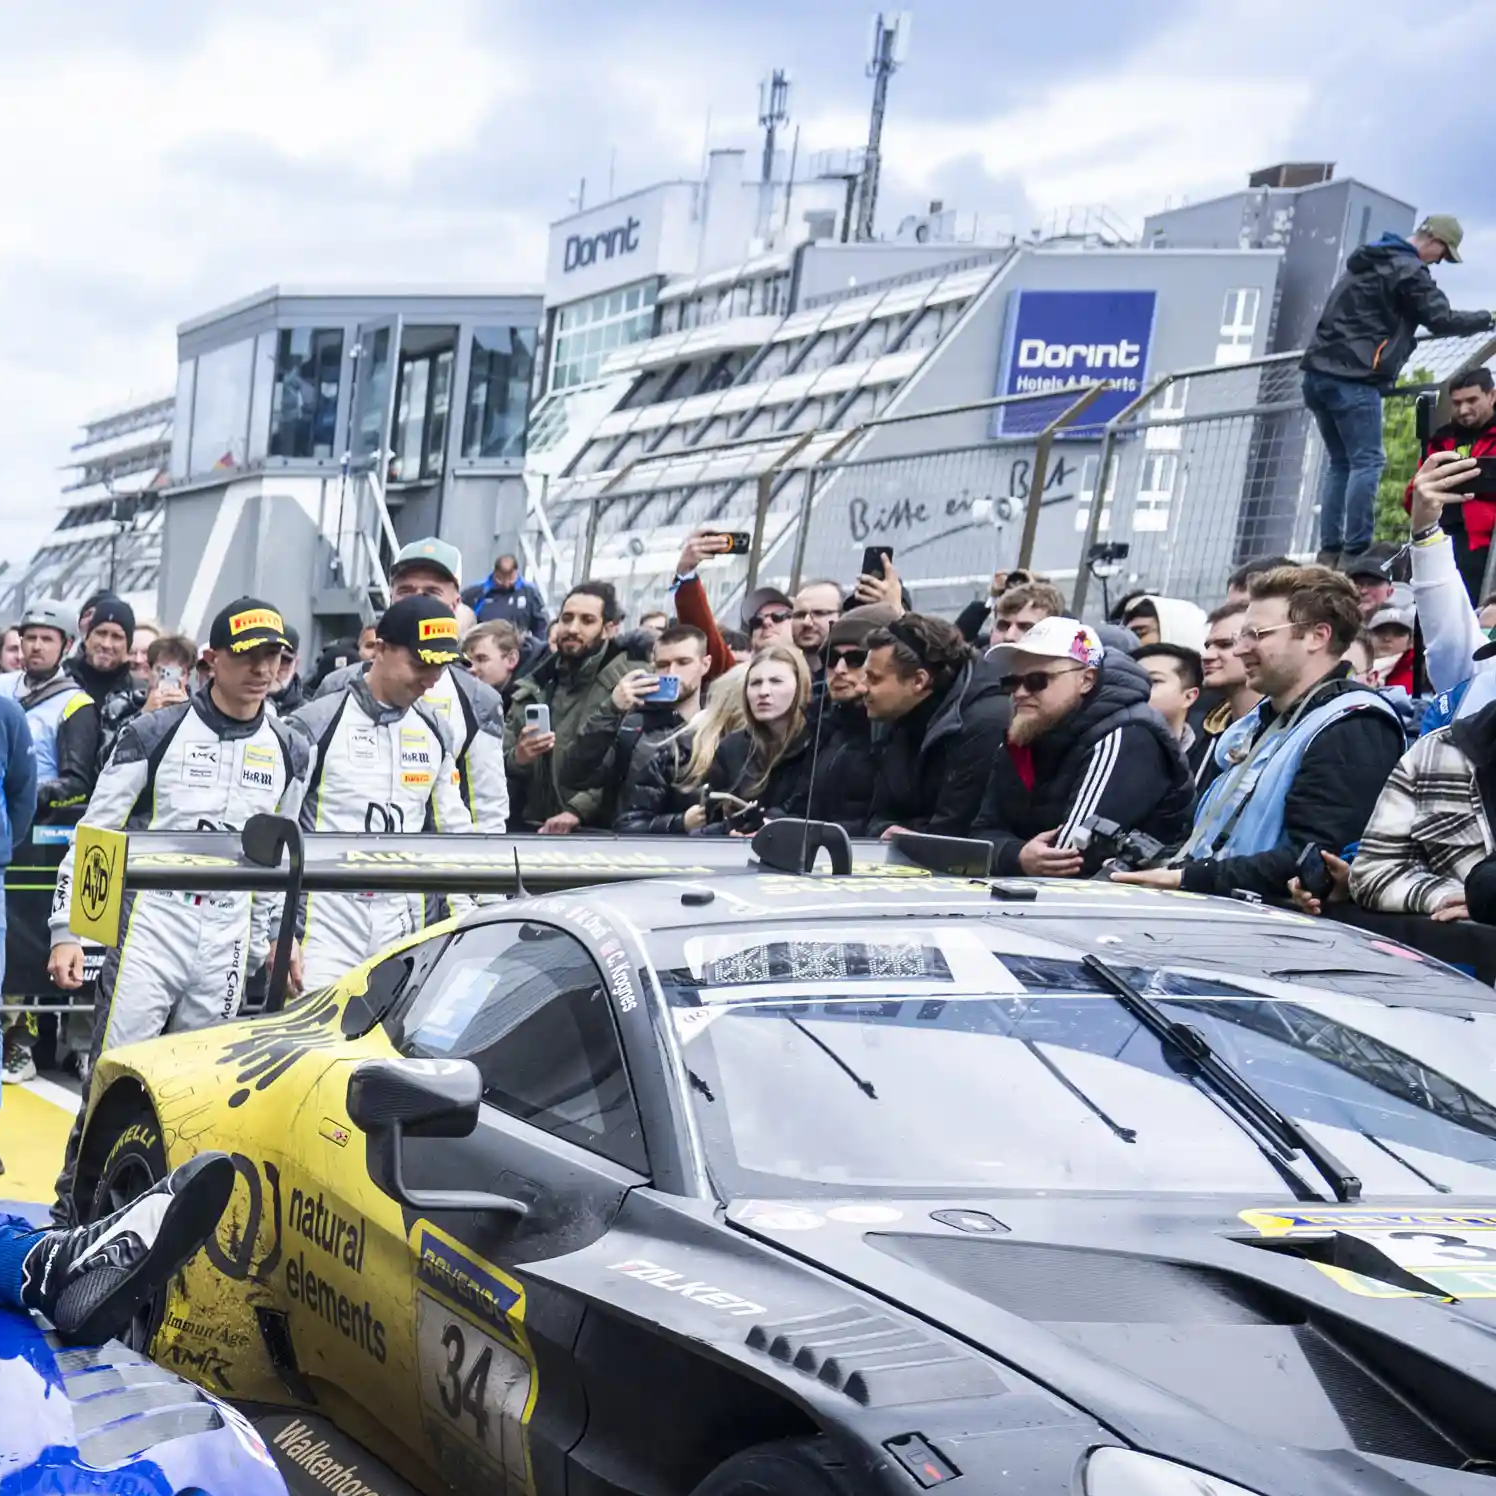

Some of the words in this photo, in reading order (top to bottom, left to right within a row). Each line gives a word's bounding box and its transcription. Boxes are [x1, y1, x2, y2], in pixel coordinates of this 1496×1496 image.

[564, 216, 640, 273] Dorint
[1018, 337, 1140, 369] Dorint
[611, 962, 638, 1013] Krognes
[288, 1186, 366, 1275] natural
[285, 1251, 388, 1367] elements
[607, 1259, 768, 1316] FALKEN
[436, 1321, 494, 1443] 34
